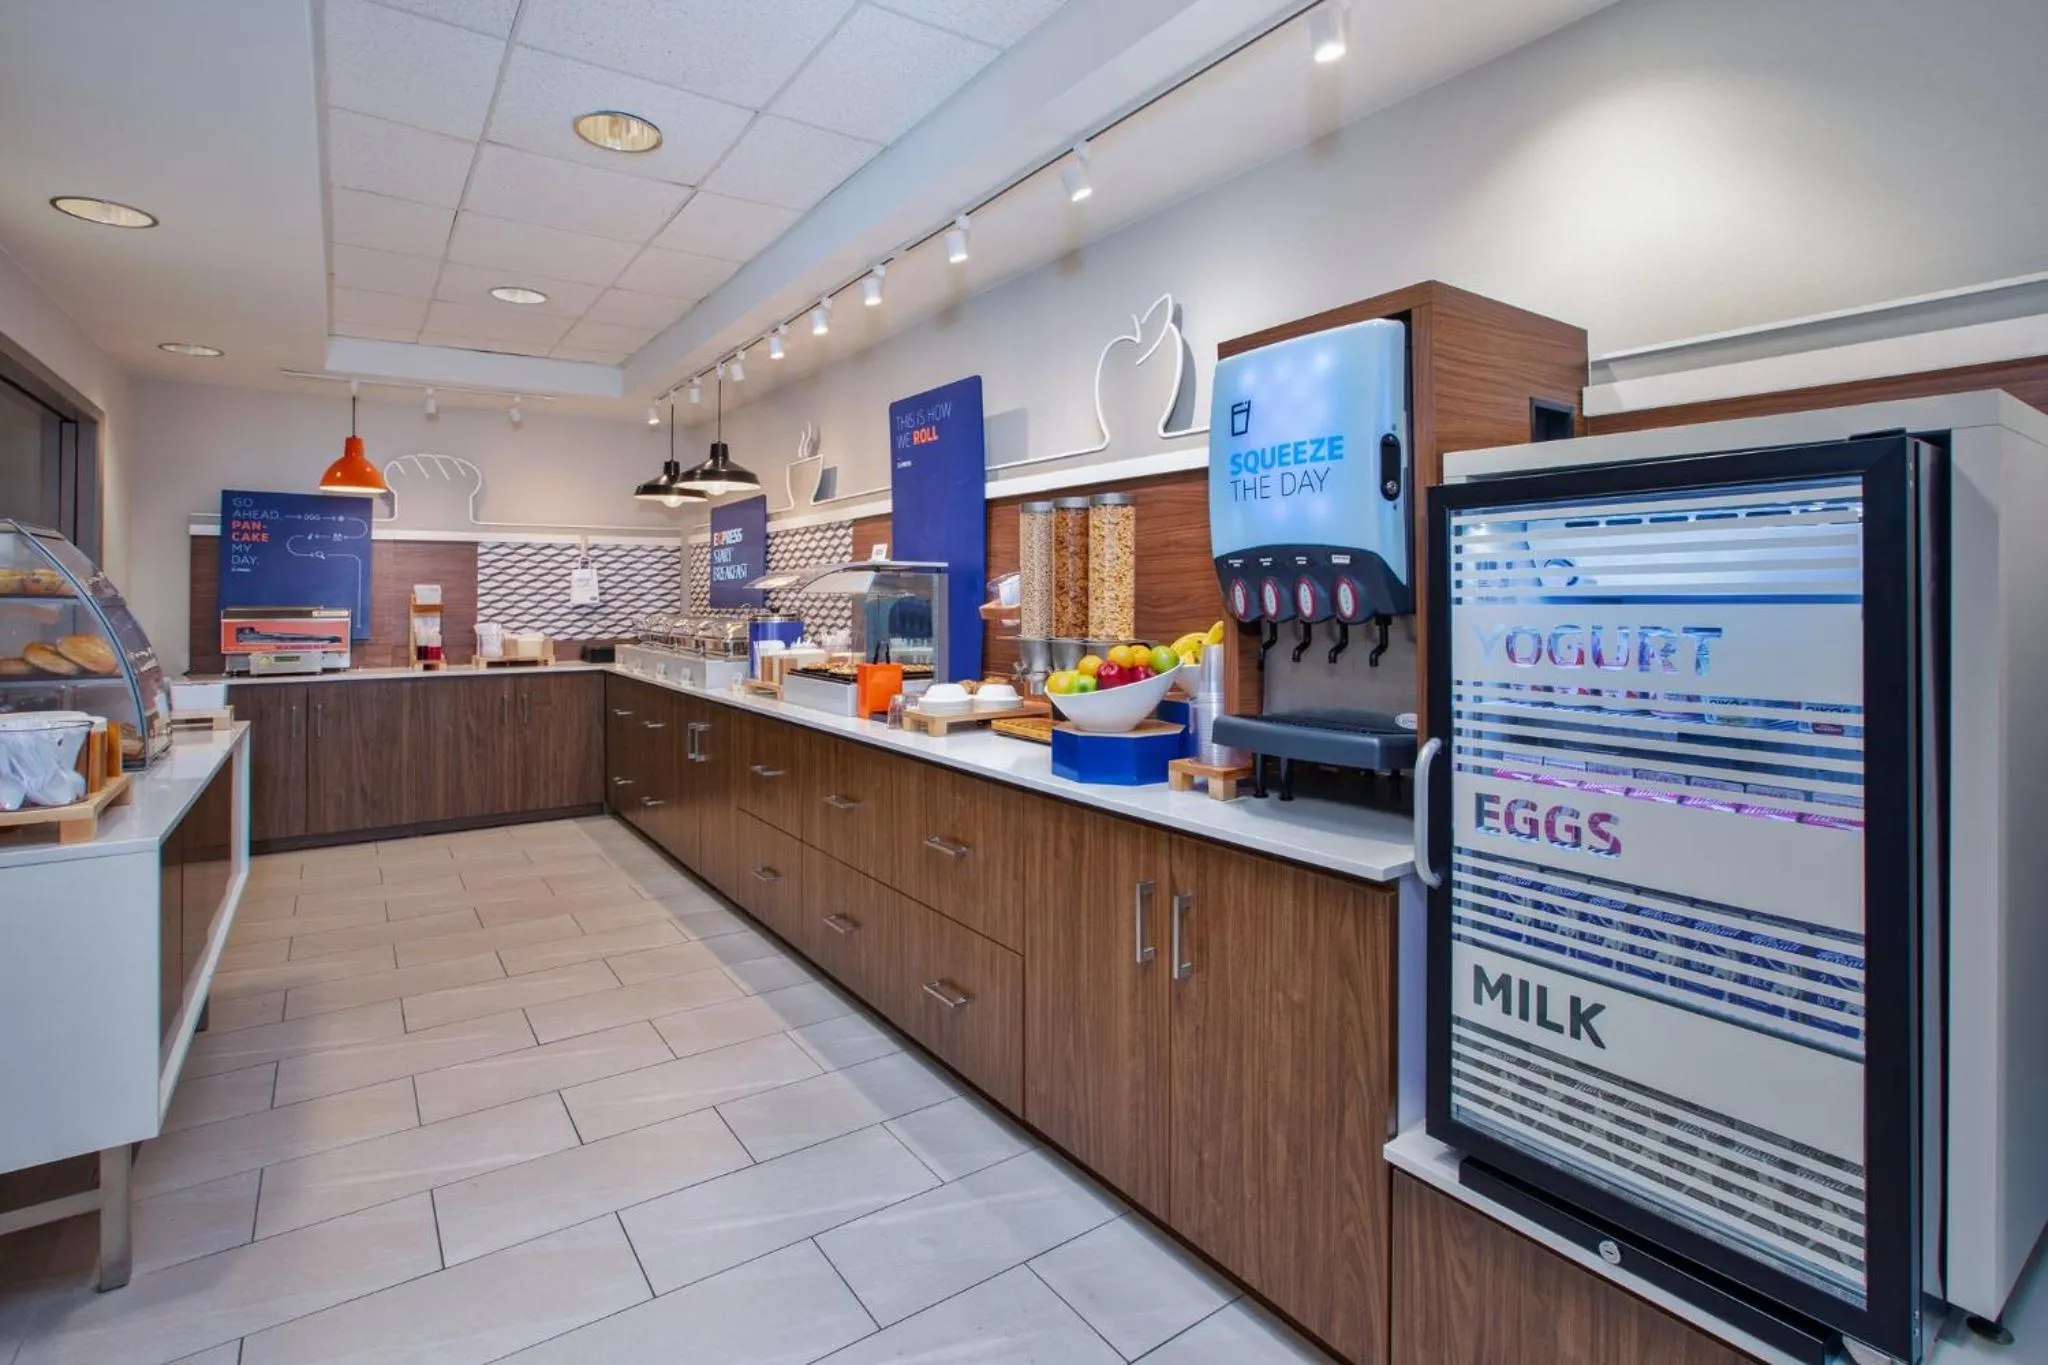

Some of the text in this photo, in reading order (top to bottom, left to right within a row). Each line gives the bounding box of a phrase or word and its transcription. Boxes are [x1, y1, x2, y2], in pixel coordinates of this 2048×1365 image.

[896, 411, 915, 430] THIS
[928, 400, 952, 424] HOW
[896, 425, 939, 449] WE ROLL
[1229, 435, 1344, 476] SQUEEZE
[1229, 467, 1330, 502] THE DAY
[232, 497, 254, 508] GO
[231, 520, 267, 530] PAN-
[231, 532, 270, 543] CAKE
[231, 544, 252, 553] MY
[1472, 624, 1723, 677] YOGURT
[1474, 792, 1622, 858] EGGS
[1473, 963, 1607, 1050] MILK
